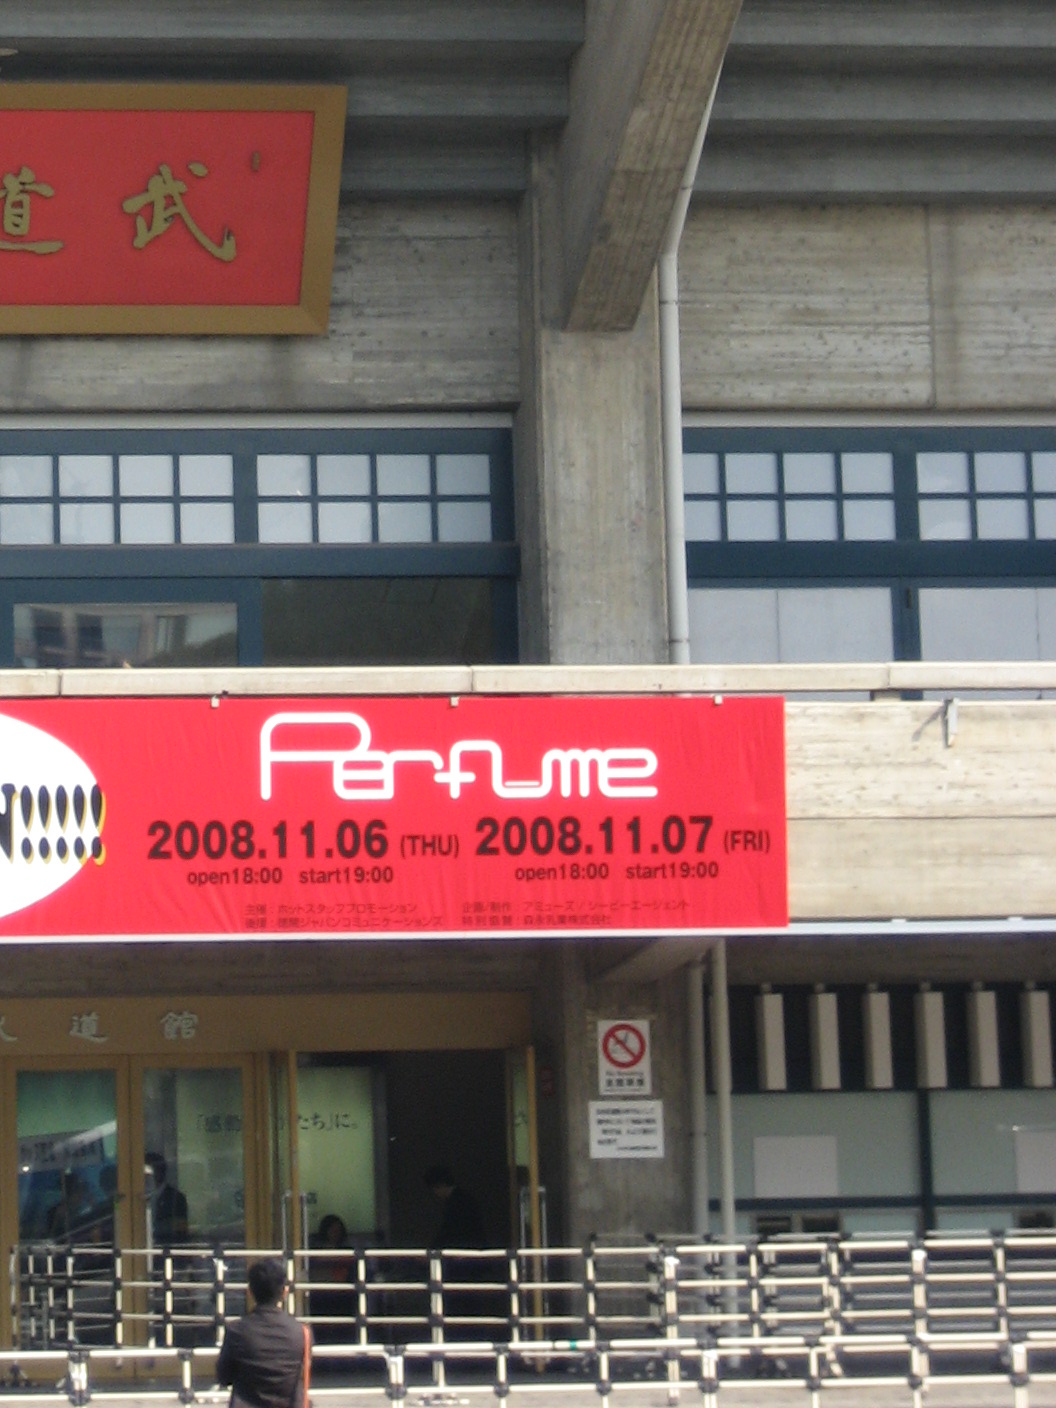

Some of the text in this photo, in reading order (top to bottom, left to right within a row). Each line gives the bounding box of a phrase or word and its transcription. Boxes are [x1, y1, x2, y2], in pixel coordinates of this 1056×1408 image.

[259, 711, 658, 801] Perfume
[147, 819, 459, 860] 2008.11.06 (THU)
[475, 814, 771, 856] 2008.11.07 (FRI)
[187, 865, 394, 886] open18:00 start19:00
[514, 860, 720, 882] open18:00 start19:00
